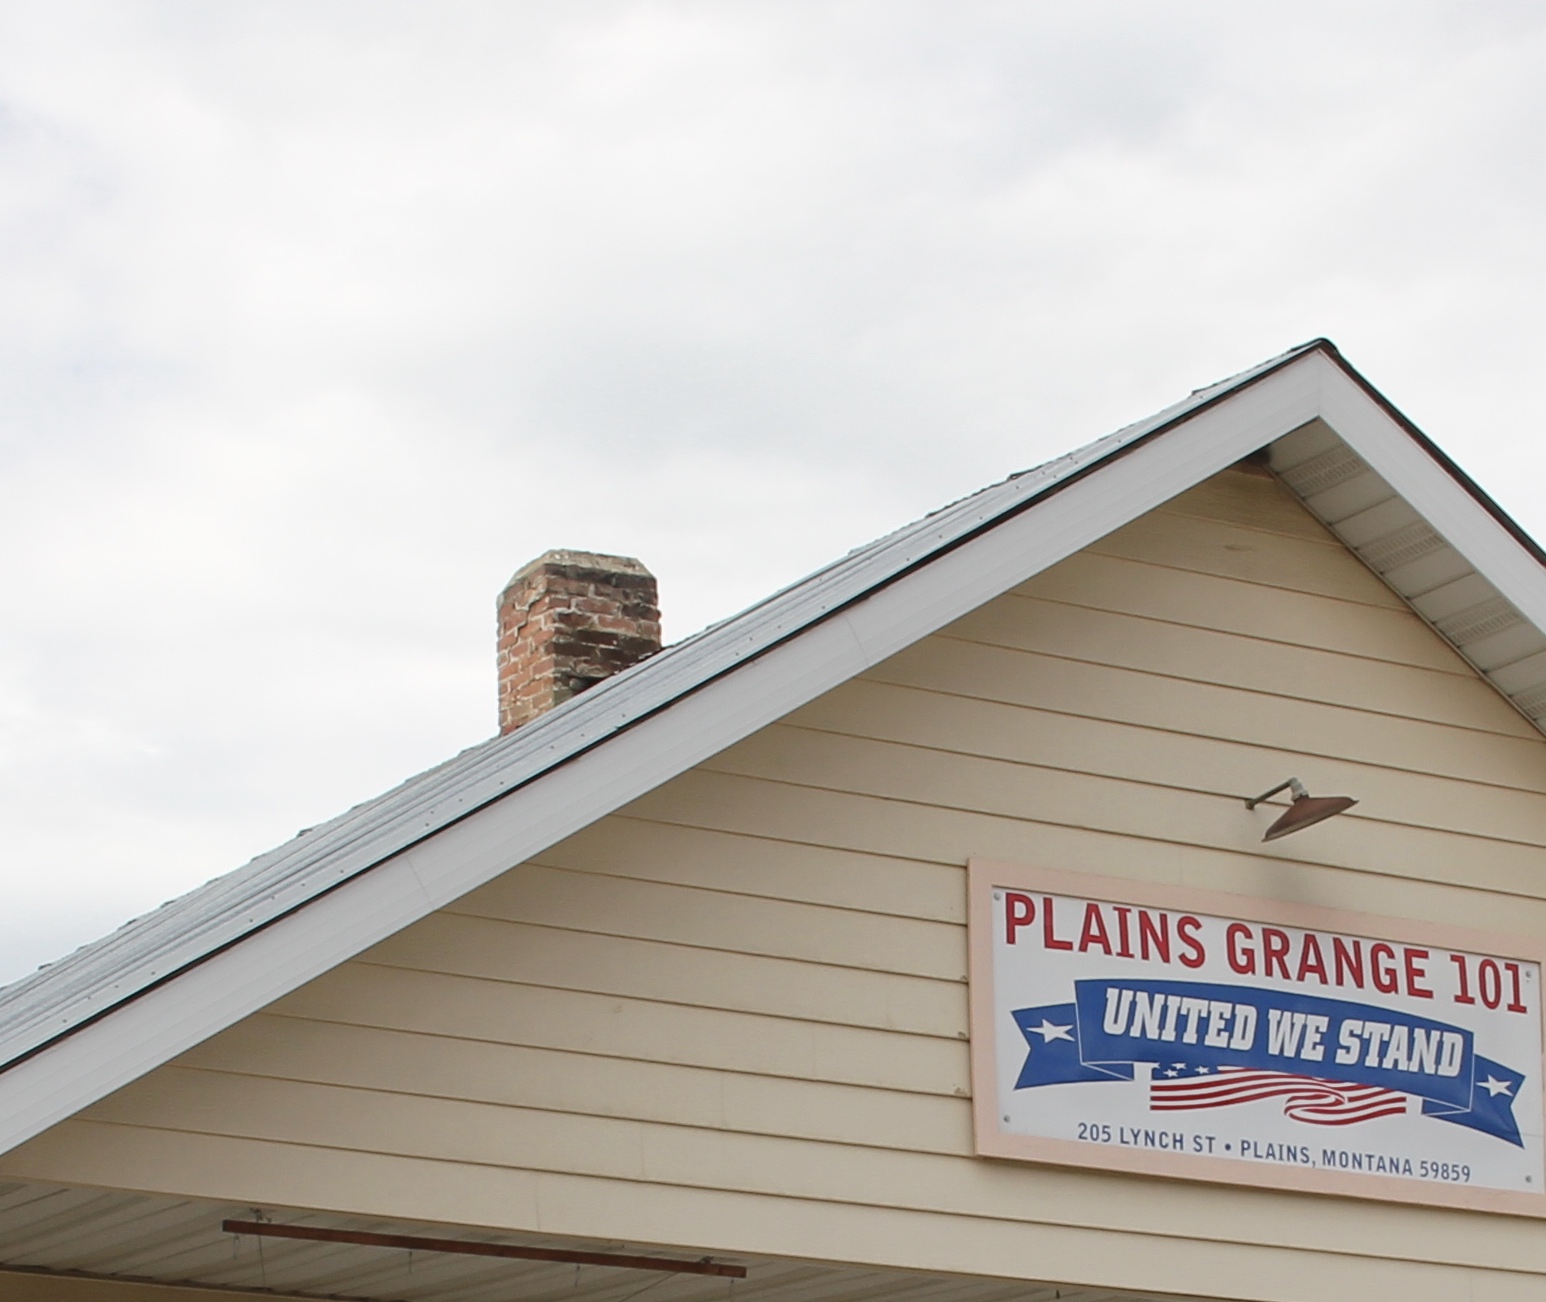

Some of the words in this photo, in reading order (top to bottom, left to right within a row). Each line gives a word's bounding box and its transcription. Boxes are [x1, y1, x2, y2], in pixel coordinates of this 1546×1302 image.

[1005, 892, 1206, 969] PLAINS
[1226, 922, 1434, 1000] GRANGE
[1450, 953, 1528, 1014] 101
[1103, 987, 1257, 1052] UNITED
[1267, 1008, 1329, 1062] WE
[1334, 1018, 1464, 1078] STAND
[1077, 1122, 1112, 1143] 205
[1119, 1126, 1184, 1151] LYNCH
[1193, 1134, 1216, 1154] ST
[1240, 1139, 1317, 1168] PLAINS,
[1322, 1149, 1414, 1176] MONTANA
[1419, 1160, 1471, 1183] 59859
